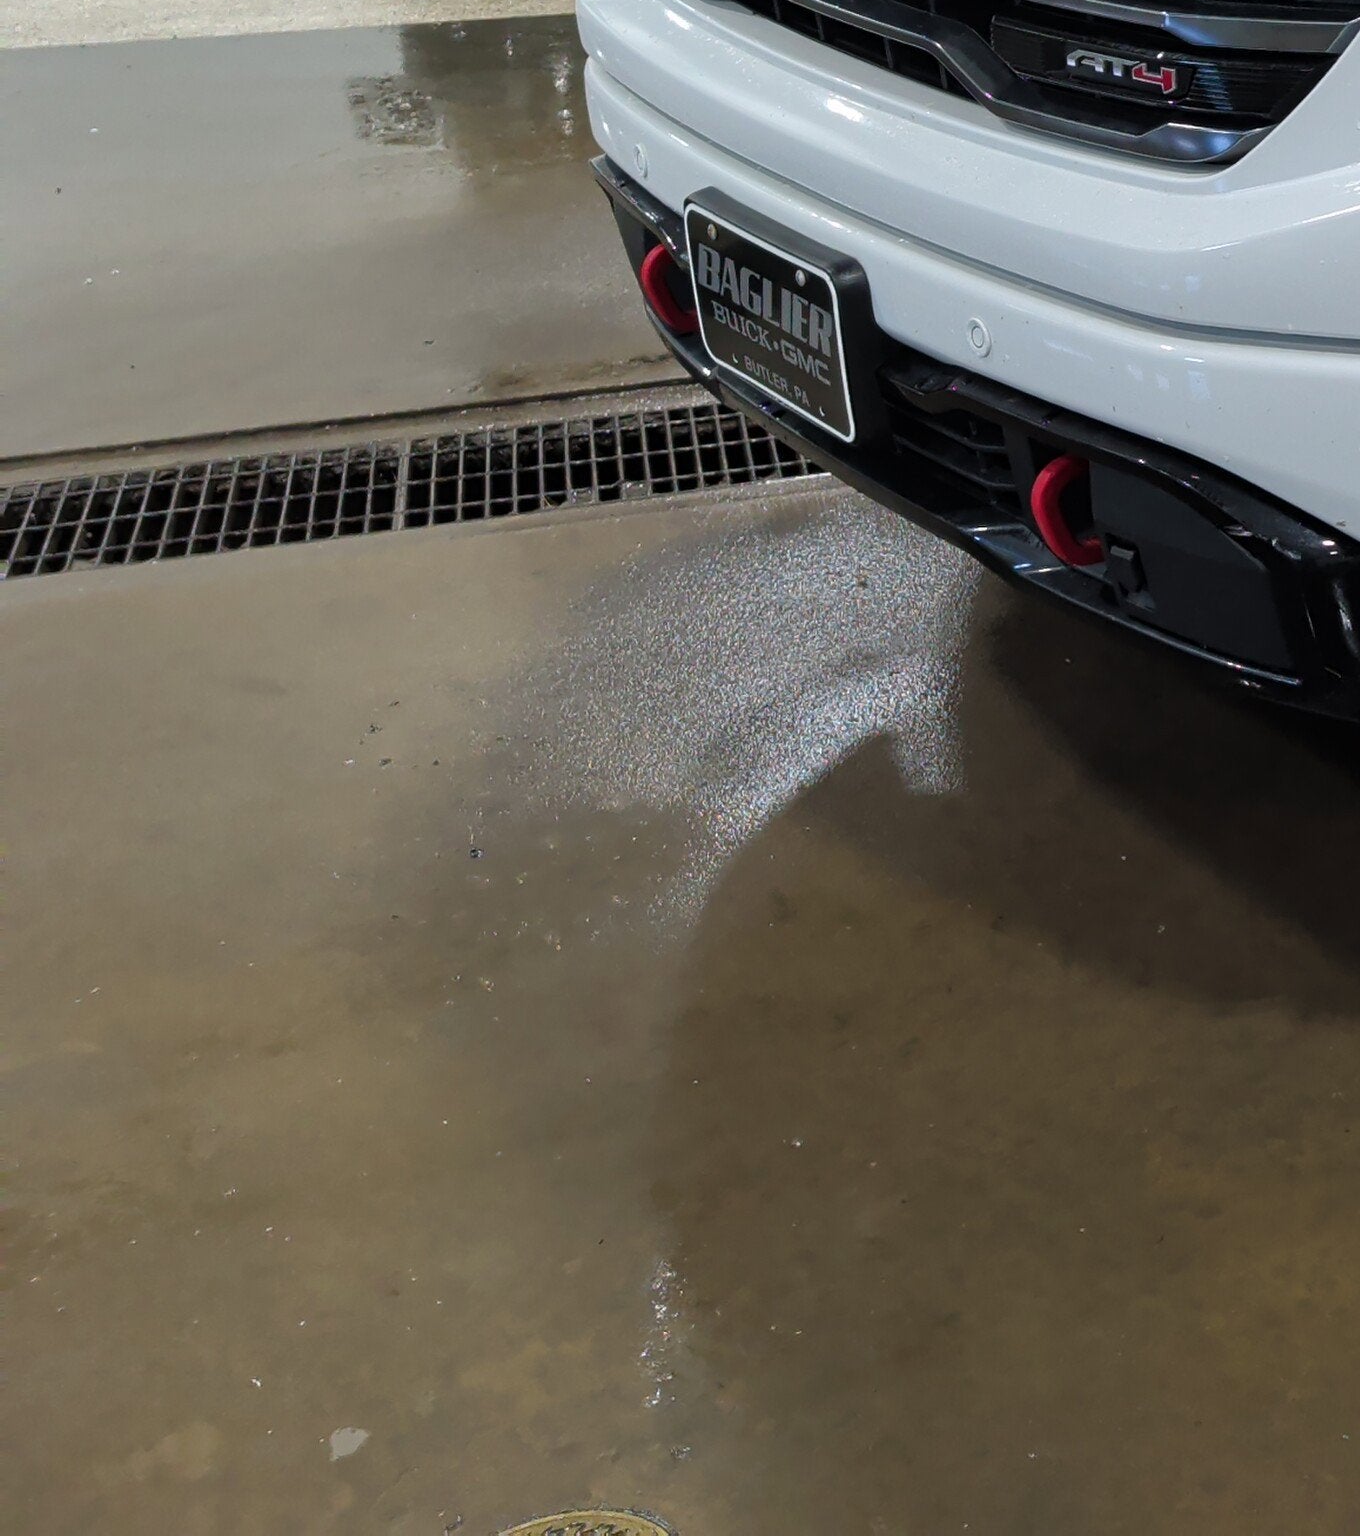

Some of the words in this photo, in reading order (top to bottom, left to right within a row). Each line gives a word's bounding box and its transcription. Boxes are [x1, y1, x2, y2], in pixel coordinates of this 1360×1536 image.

[1066, 49, 1176, 95] AT4
[698, 242, 833, 358] BAGLIER
[793, 389, 812, 407] PA
